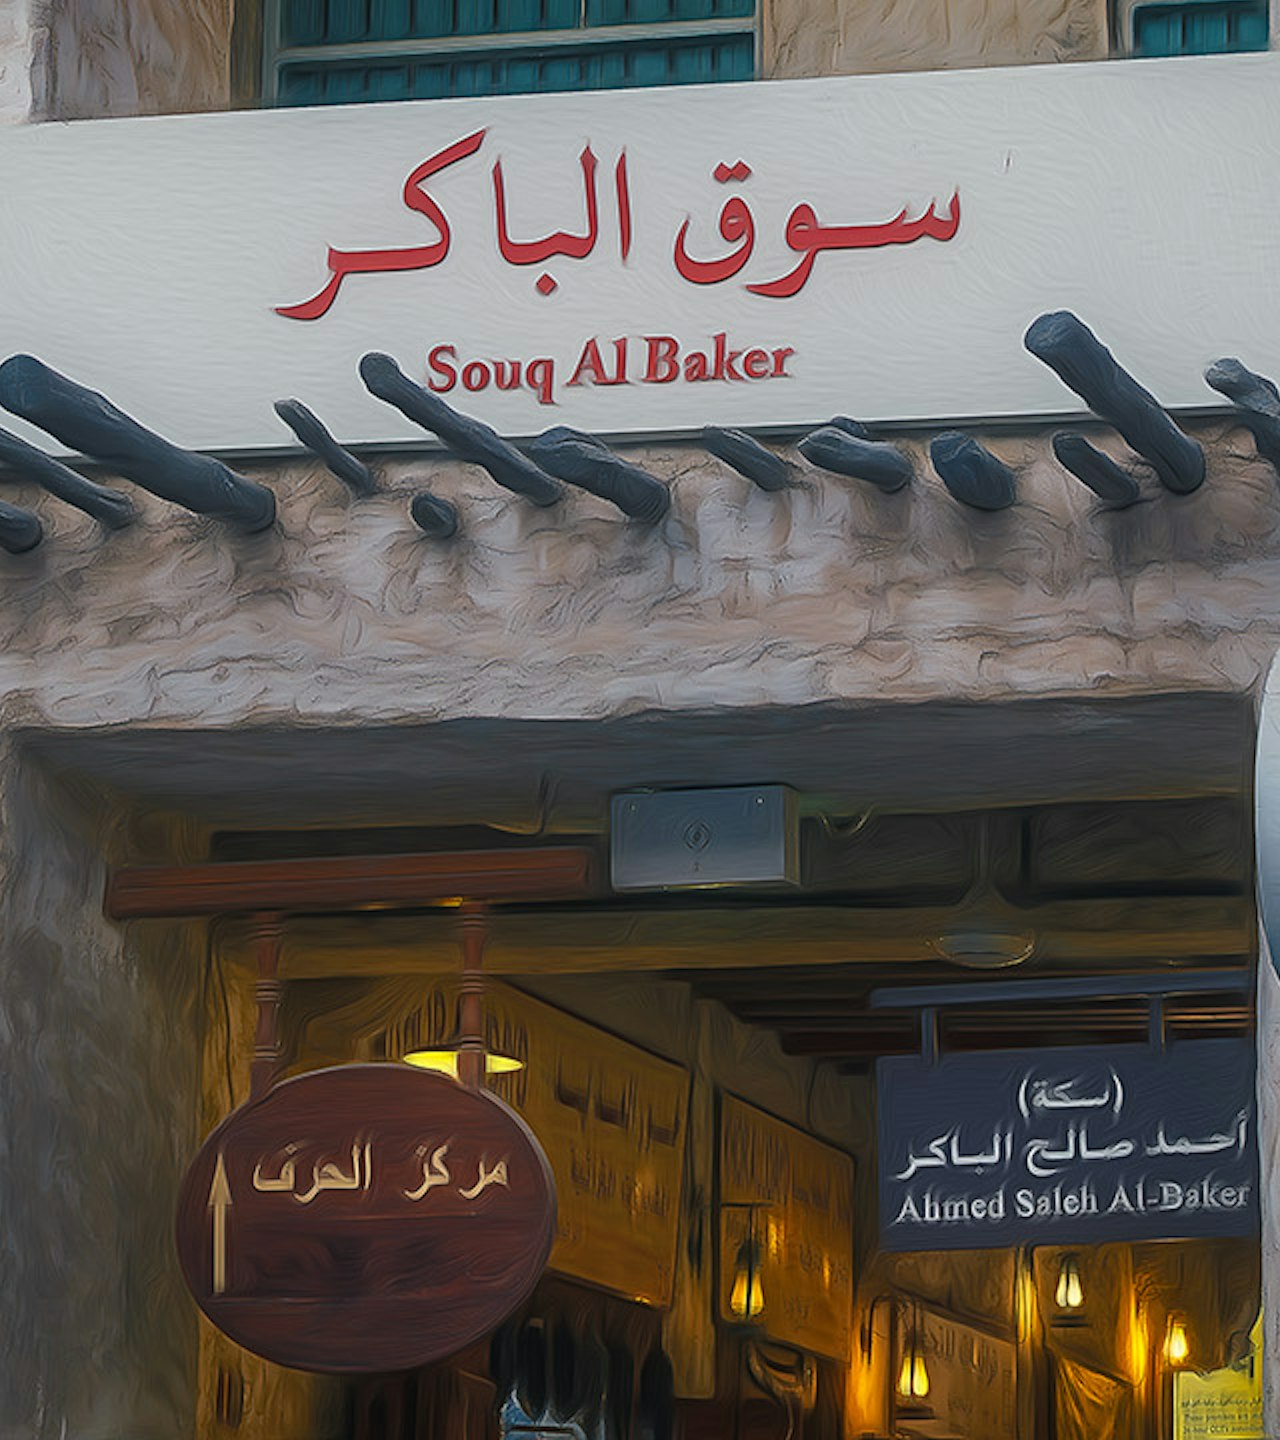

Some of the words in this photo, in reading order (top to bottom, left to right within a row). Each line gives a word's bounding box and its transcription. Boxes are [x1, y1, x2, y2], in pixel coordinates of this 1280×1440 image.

[273, 128, 632, 320] الباكر
[672, 160, 962, 299] سوق
[427, 344, 558, 405] Souq
[568, 337, 629, 386] Al
[644, 332, 795, 383] Baker
[896, 1132, 1013, 1180] الباكر
[1026, 1128, 1135, 1178] صالح
[1145, 1110, 1249, 1158] أحمد
[252, 1141, 373, 1203] الحرف
[404, 1143, 509, 1201] مركز
[895, 1188, 1005, 1223] Ahmed
[1016, 1185, 1099, 1219] Saleh
[1108, 1180, 1250, 1213] Al-Baker
